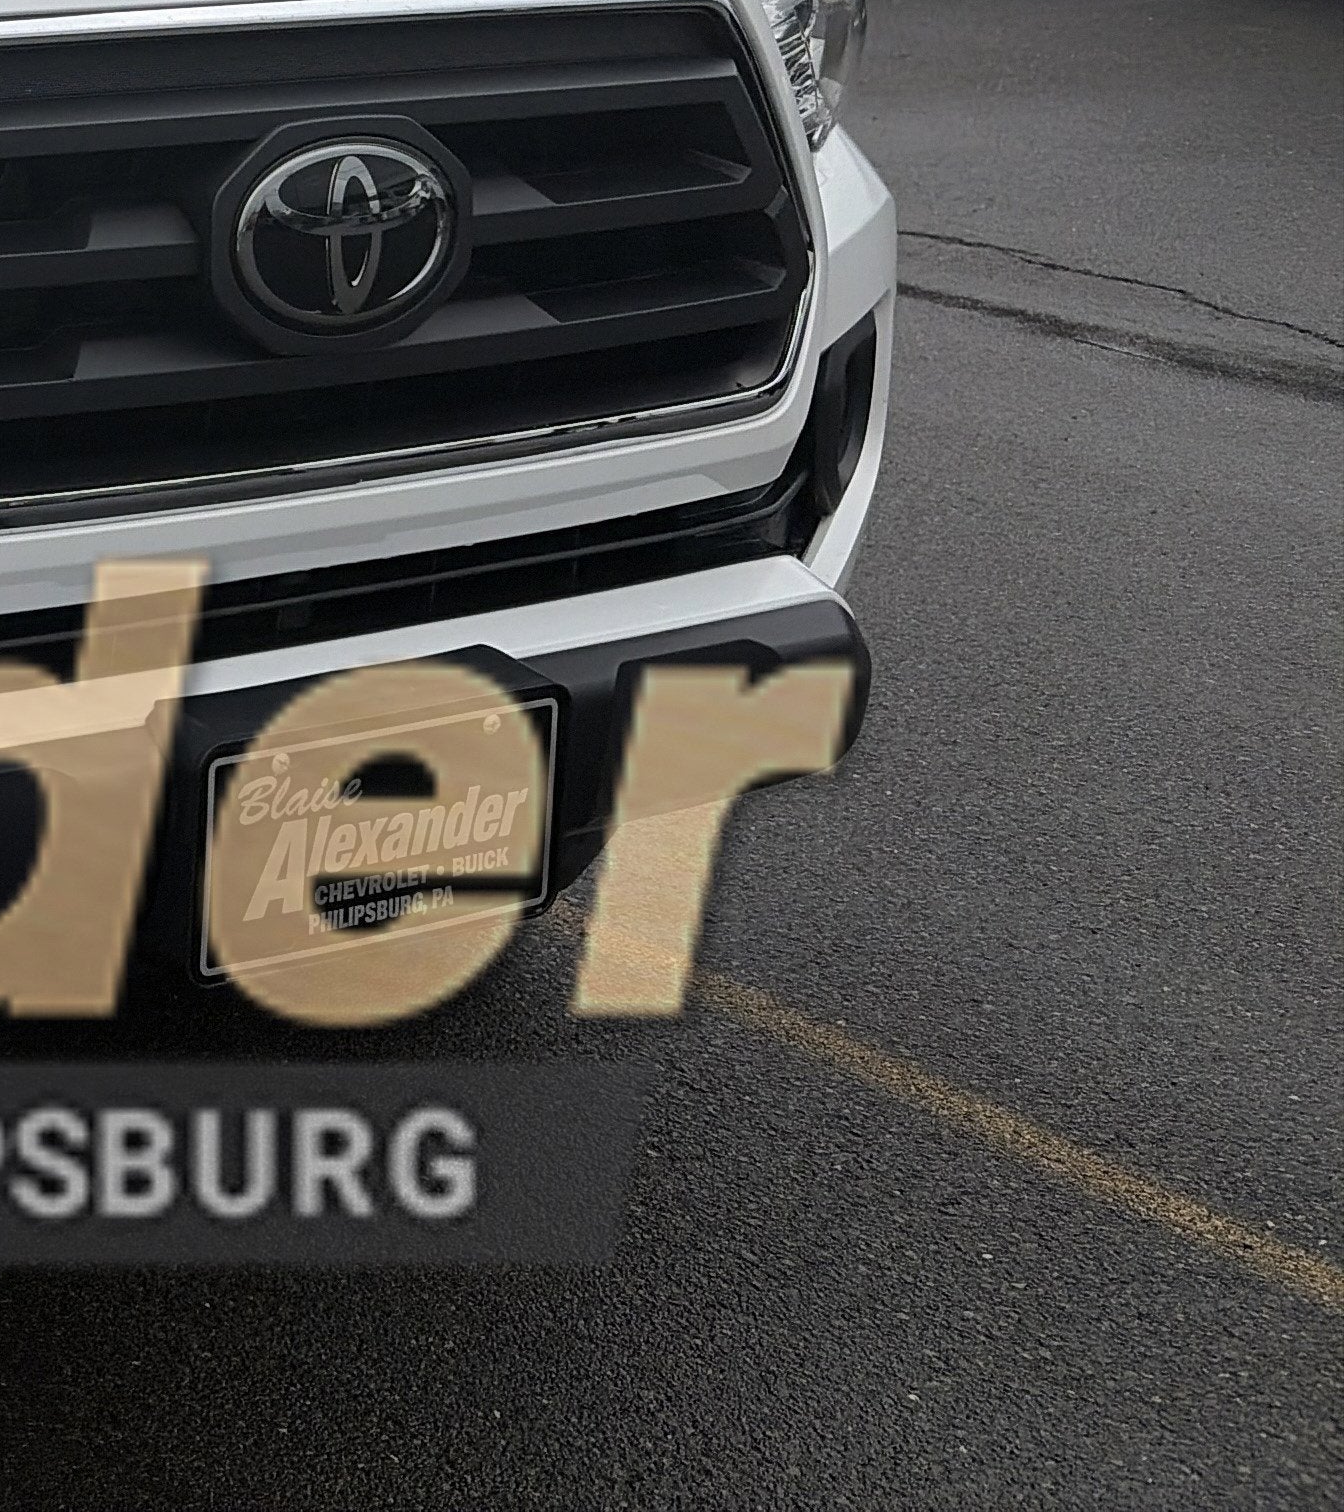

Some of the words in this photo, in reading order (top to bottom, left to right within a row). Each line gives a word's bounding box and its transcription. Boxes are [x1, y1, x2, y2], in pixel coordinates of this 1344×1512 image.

[237, 774, 363, 827] Blaise
[242, 784, 530, 922] Alexander
[313, 862, 430, 906] CHEVROLET
[451, 845, 510, 879] BUICK
[431, 884, 455, 909] PA
